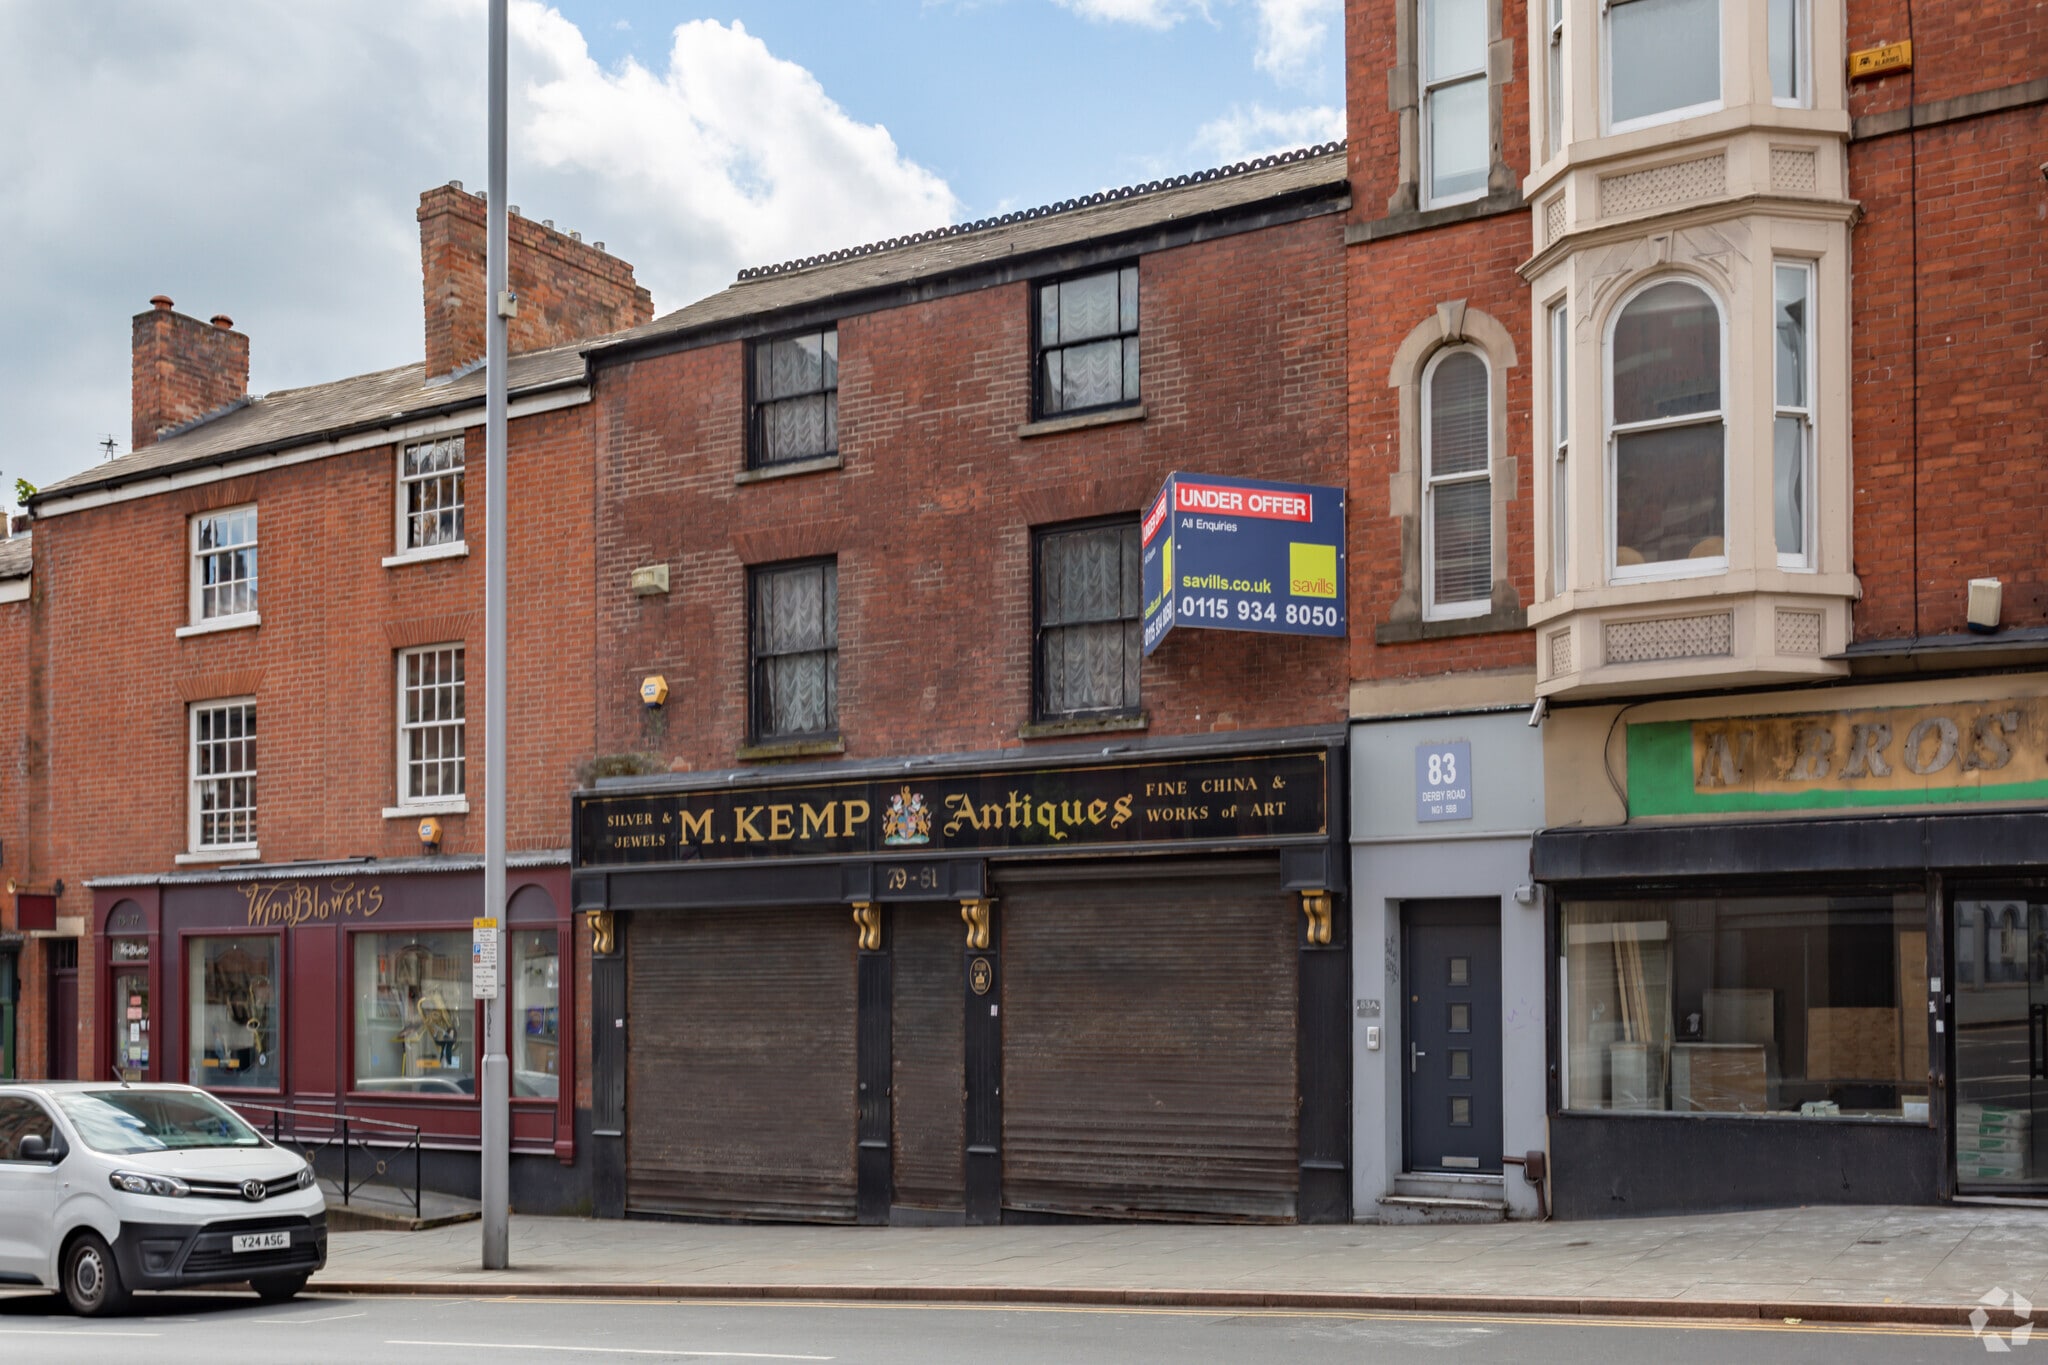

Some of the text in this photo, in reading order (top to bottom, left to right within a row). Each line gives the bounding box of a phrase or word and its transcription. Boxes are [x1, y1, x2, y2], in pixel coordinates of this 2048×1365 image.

[1181, 489, 1306, 516] UNDER OFFER
[1182, 518, 1238, 533] All Enquiries
[1182, 574, 1271, 593] savills.co.uk
[1292, 578, 1334, 595] savills
[1182, 596, 1229, 619] 0115
[1237, 600, 1277, 622] 934
[1285, 604, 1337, 627] 8050
[1428, 753, 1456, 785] 83
[1145, 775, 1286, 797] FINE CHINA &
[1422, 789, 1466, 802] DERBY ROAD
[607, 812, 672, 828] SILVER &
[943, 790, 1134, 841] Antiques
[1147, 801, 1287, 823] WORKS of ART
[615, 833, 666, 849] JEWELS
[237, 880, 384, 928] WindBlowers
[1360, 1000, 1376, 1009] 83A
